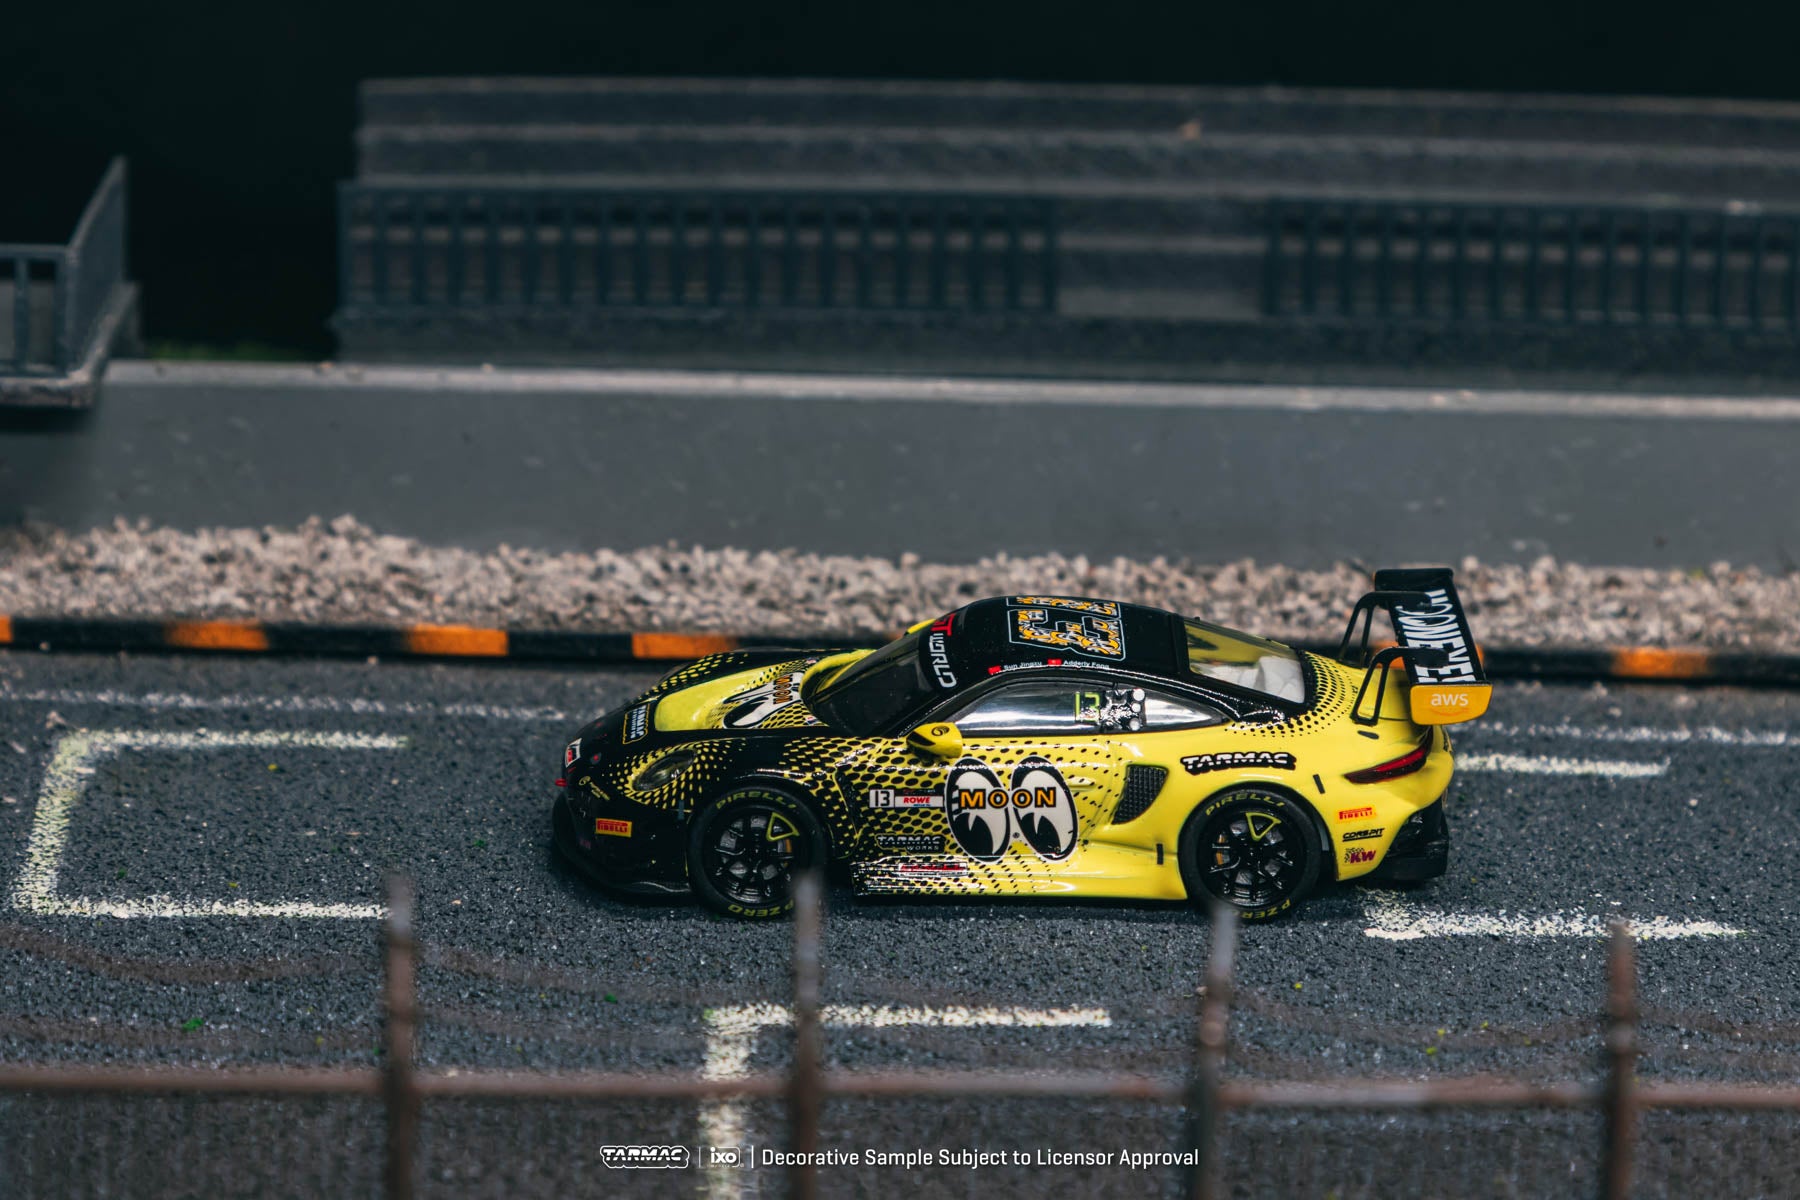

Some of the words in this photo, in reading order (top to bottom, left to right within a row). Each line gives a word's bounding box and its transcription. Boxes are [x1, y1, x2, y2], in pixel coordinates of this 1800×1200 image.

[928, 633, 957, 688] WORLD
[1075, 691, 1100, 722] 13
[1431, 693, 1469, 707] aws
[1182, 751, 1291, 771] TARMAC
[716, 791, 797, 809] PIRELLI
[874, 790, 890, 807] 13
[903, 796, 931, 804] ROWE
[959, 787, 1056, 809] MOON
[1205, 793, 1285, 816] PIRELLI
[1338, 807, 1373, 820] PIRELLI
[597, 819, 629, 833] PIRELLI
[877, 836, 941, 845] TARMAC
[1350, 850, 1377, 864] KW
[728, 904, 781, 917] ZERO
[1281, 899, 1291, 910] P
